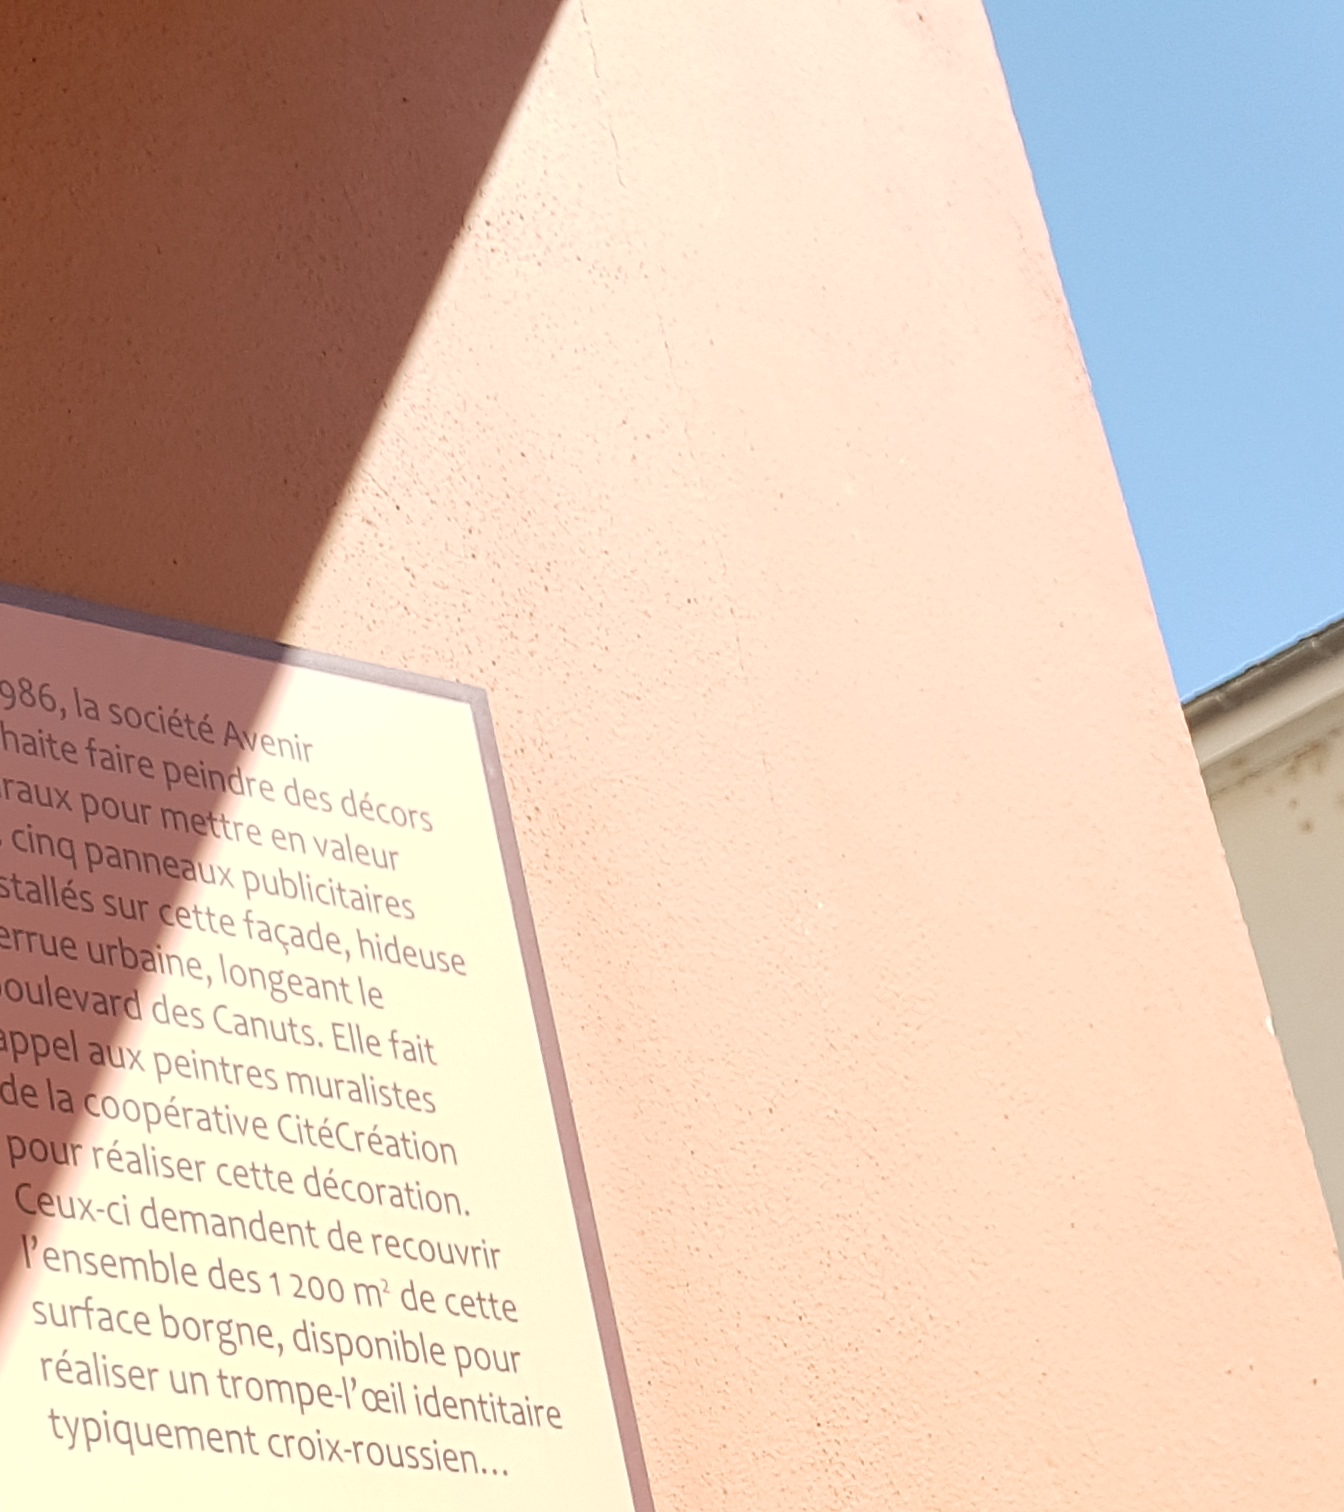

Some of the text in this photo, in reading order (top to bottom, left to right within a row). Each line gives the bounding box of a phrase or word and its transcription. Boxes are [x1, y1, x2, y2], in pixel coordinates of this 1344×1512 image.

[71, 685, 101, 723] la
[107, 702, 216, 746] société
[222, 719, 314, 764] Avenir
[83, 735, 156, 781] faire
[161, 758, 276, 803] peindre
[282, 776, 334, 814] des
[339, 788, 434, 833] décors
[10, 822, 79, 872] cinq
[83, 840, 236, 889] panneaux
[241, 866, 416, 921] publicitaires
[78, 791, 153, 827] pour
[159, 806, 264, 847] mettre
[270, 827, 307, 856] en
[311, 832, 400, 872] valeur
[85, 935, 214, 989] urbaine,
[218, 952, 354, 1006] longeant
[356, 974, 385, 1011] le
[101, 892, 151, 923] sur
[157, 902, 237, 938] cette
[241, 908, 352, 964] façade,
[355, 927, 468, 977] hideuse
[151, 993, 206, 1031] des
[211, 1003, 325, 1049] Canuts.
[330, 1021, 384, 1059] Elle
[387, 1027, 439, 1067] fait
[86, 1040, 146, 1073] aux
[152, 1048, 280, 1092] peintres
[285, 1070, 437, 1115] muralistes
[44, 1076, 76, 1115] la
[82, 1092, 271, 1142] coopérative
[276, 1112, 459, 1167] CitéCréation
[5, 1133, 471, 1218] pour réaliser cette décoration.
[13, 1181, 502, 1271] Ceux-ci demandent de recouvrir
[206, 1256, 263, 1295] des
[399, 1278, 438, 1315] de
[443, 1290, 520, 1324] cette
[31, 1294, 522, 1379] surface borgne, disponible pour
[39, 1348, 160, 1392] réaliser
[167, 1369, 210, 1397] un
[411, 1383, 564, 1431] identitaire
[47, 1407, 509, 1478] typiquement croix-roussien...
